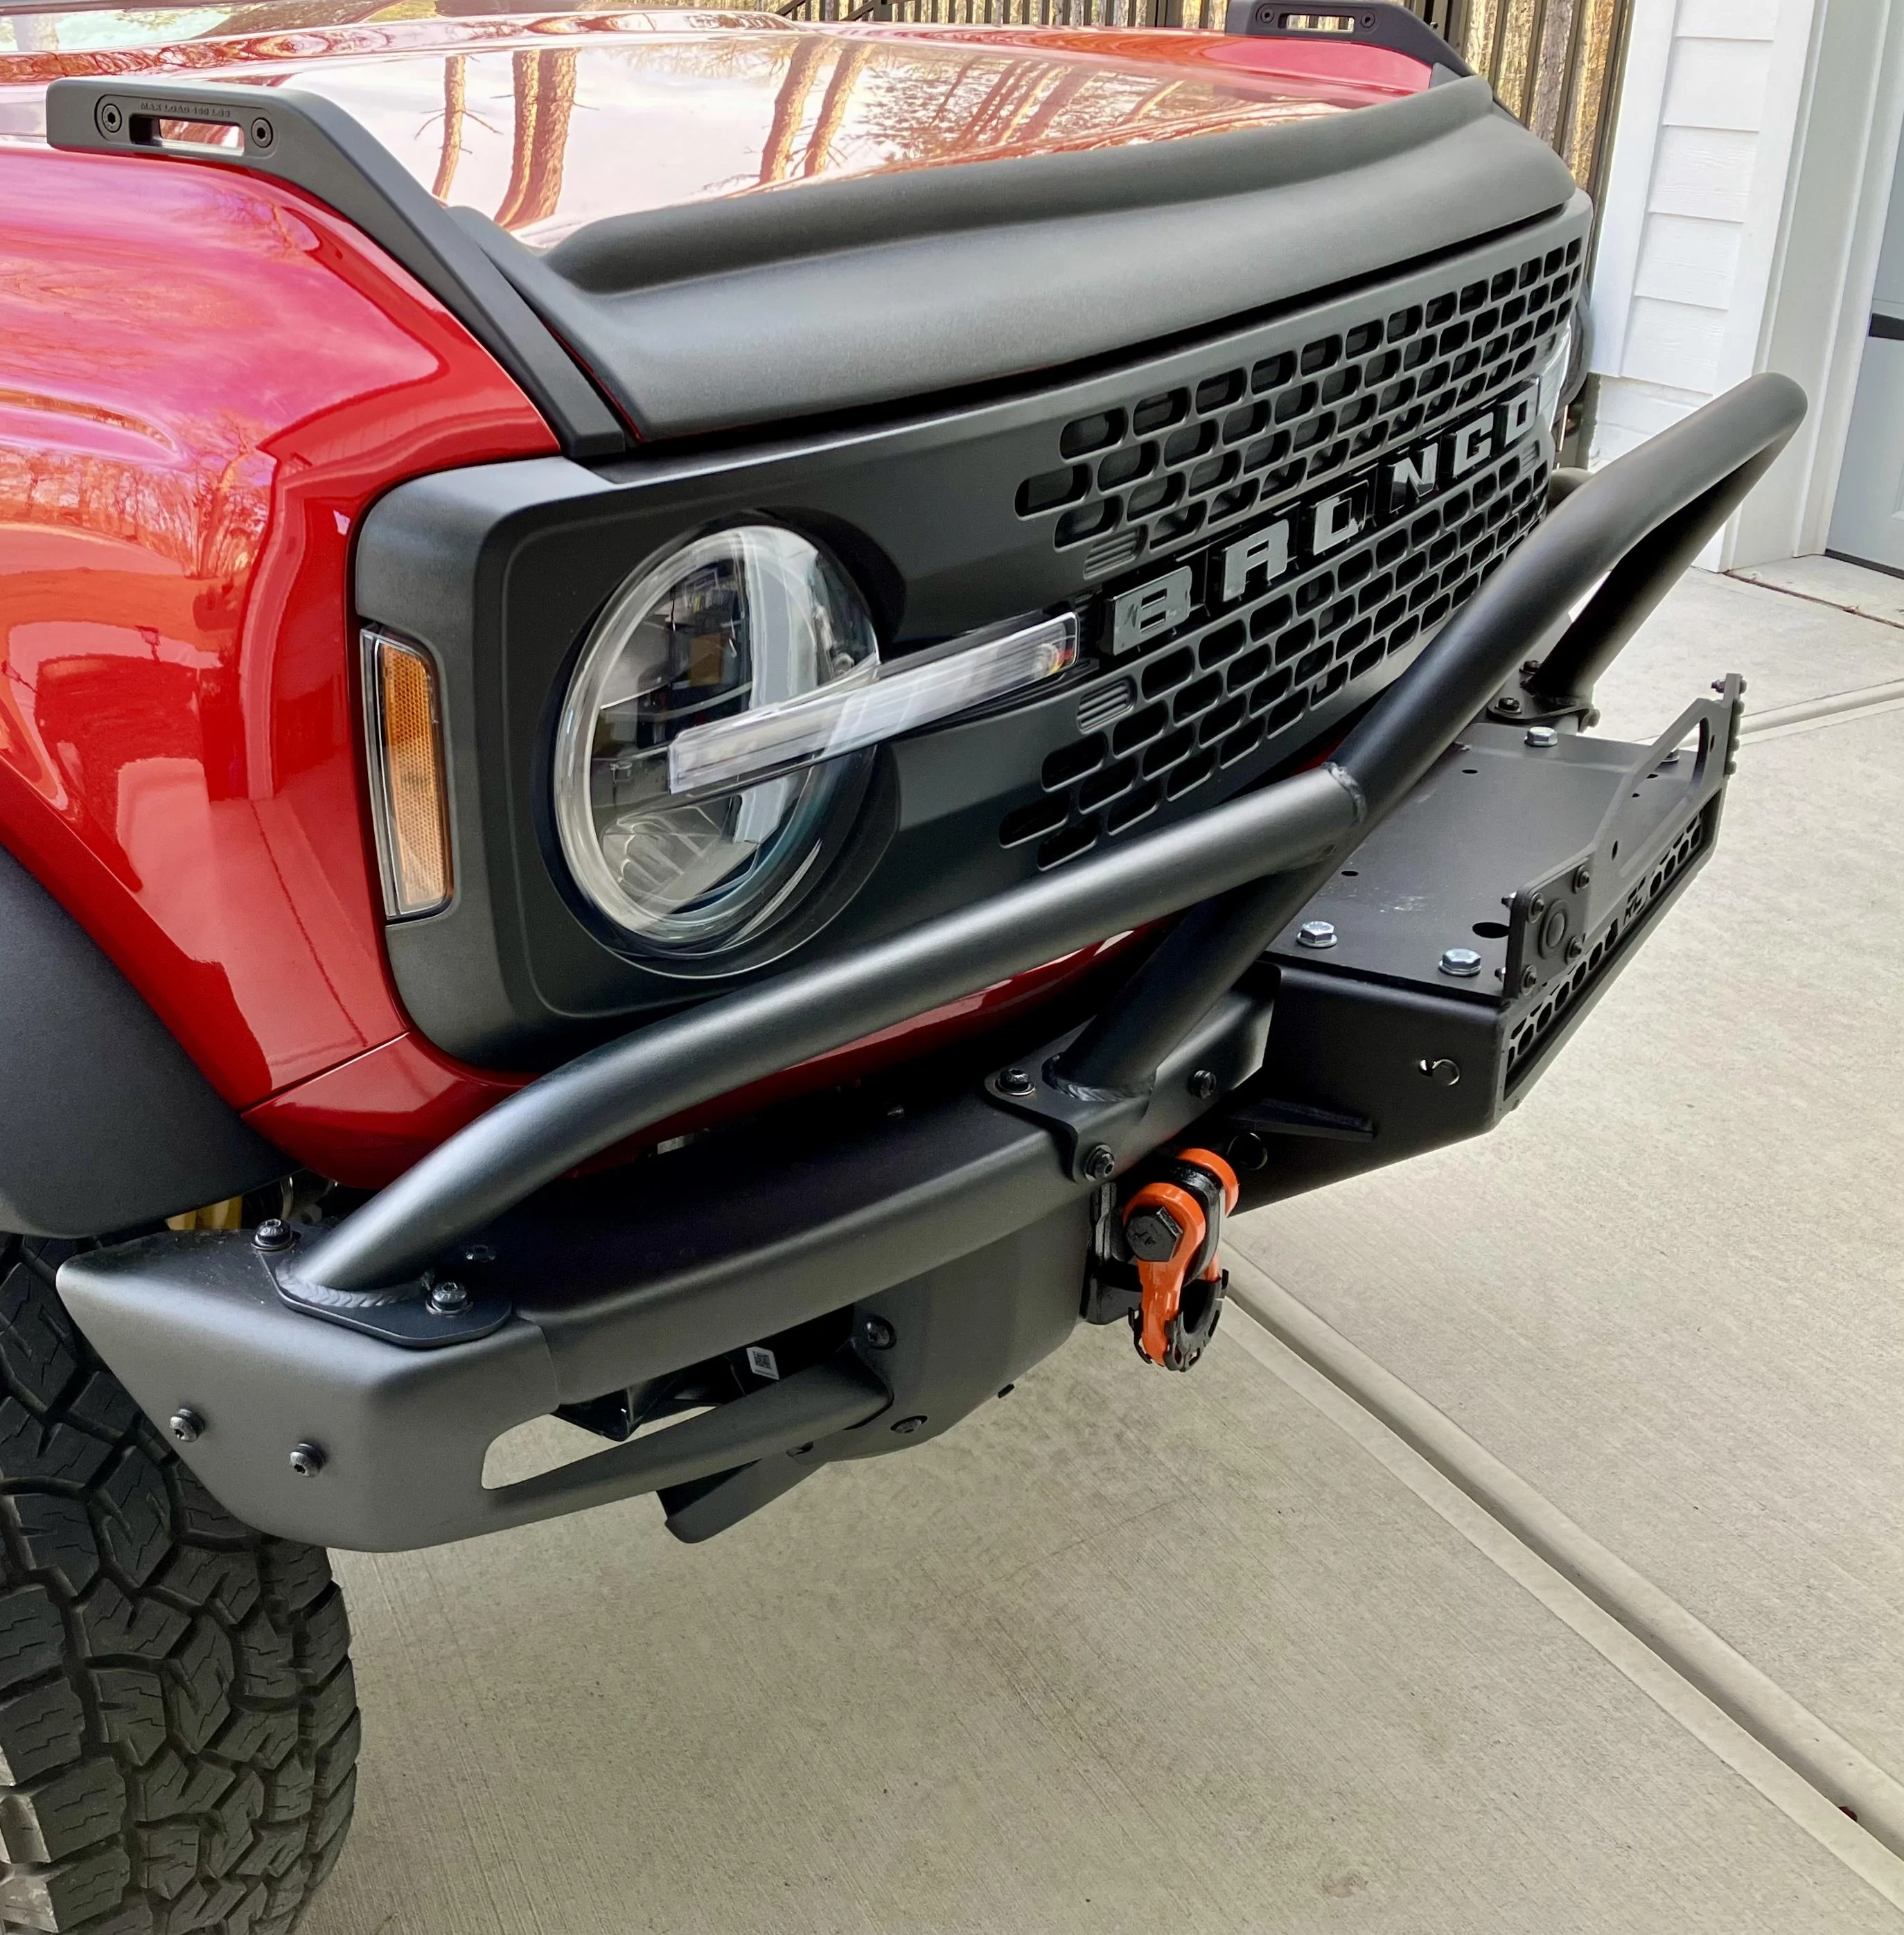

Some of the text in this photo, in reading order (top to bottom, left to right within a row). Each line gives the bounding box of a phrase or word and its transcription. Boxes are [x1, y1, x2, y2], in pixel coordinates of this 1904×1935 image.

[141, 102, 161, 112] MAX
[165, 105, 189, 114] LOAD
[1112, 377, 1539, 656] BRONCO
